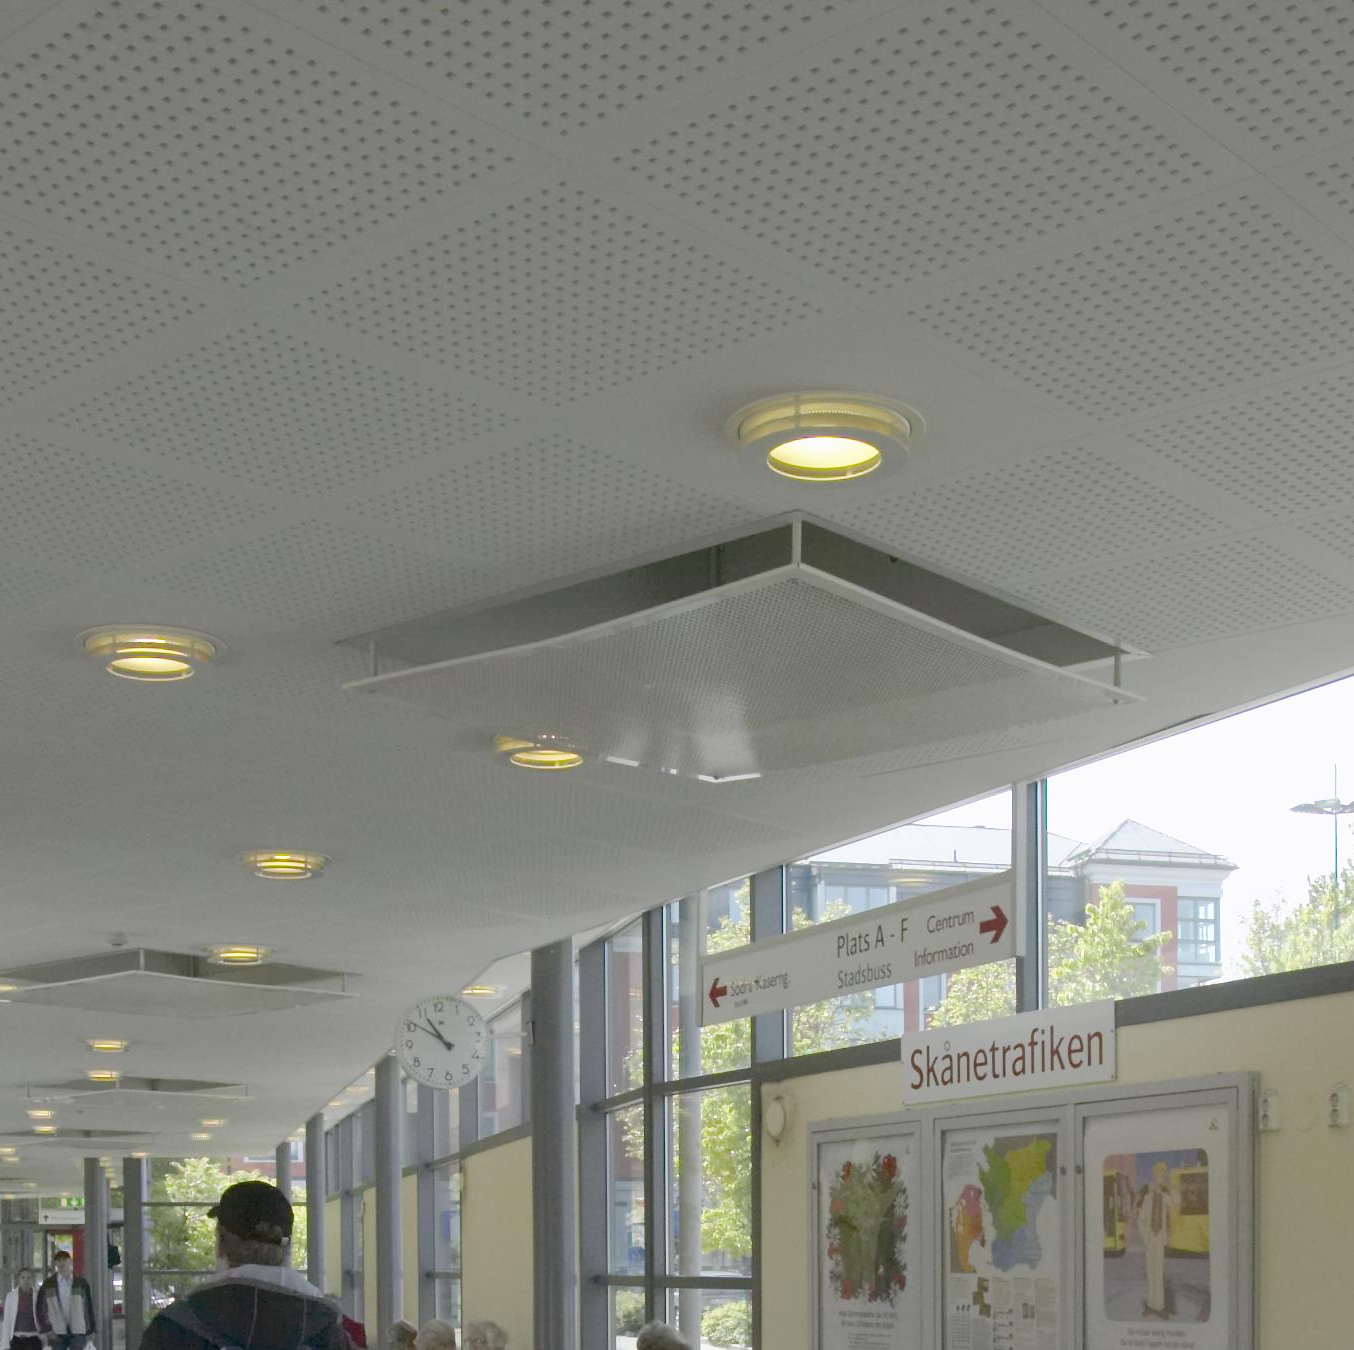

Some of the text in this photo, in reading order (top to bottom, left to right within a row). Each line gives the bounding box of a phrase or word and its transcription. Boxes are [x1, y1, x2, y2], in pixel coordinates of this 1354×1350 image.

[927, 911, 975, 934] Centrum
[837, 932, 870, 959] Plats
[875, 924, 885, 949] A
[900, 917, 909, 943] F
[914, 940, 975, 968] Information
[837, 962, 892, 989] Stadsbuss
[909, 1024, 1105, 1091] Skånetrafiken
